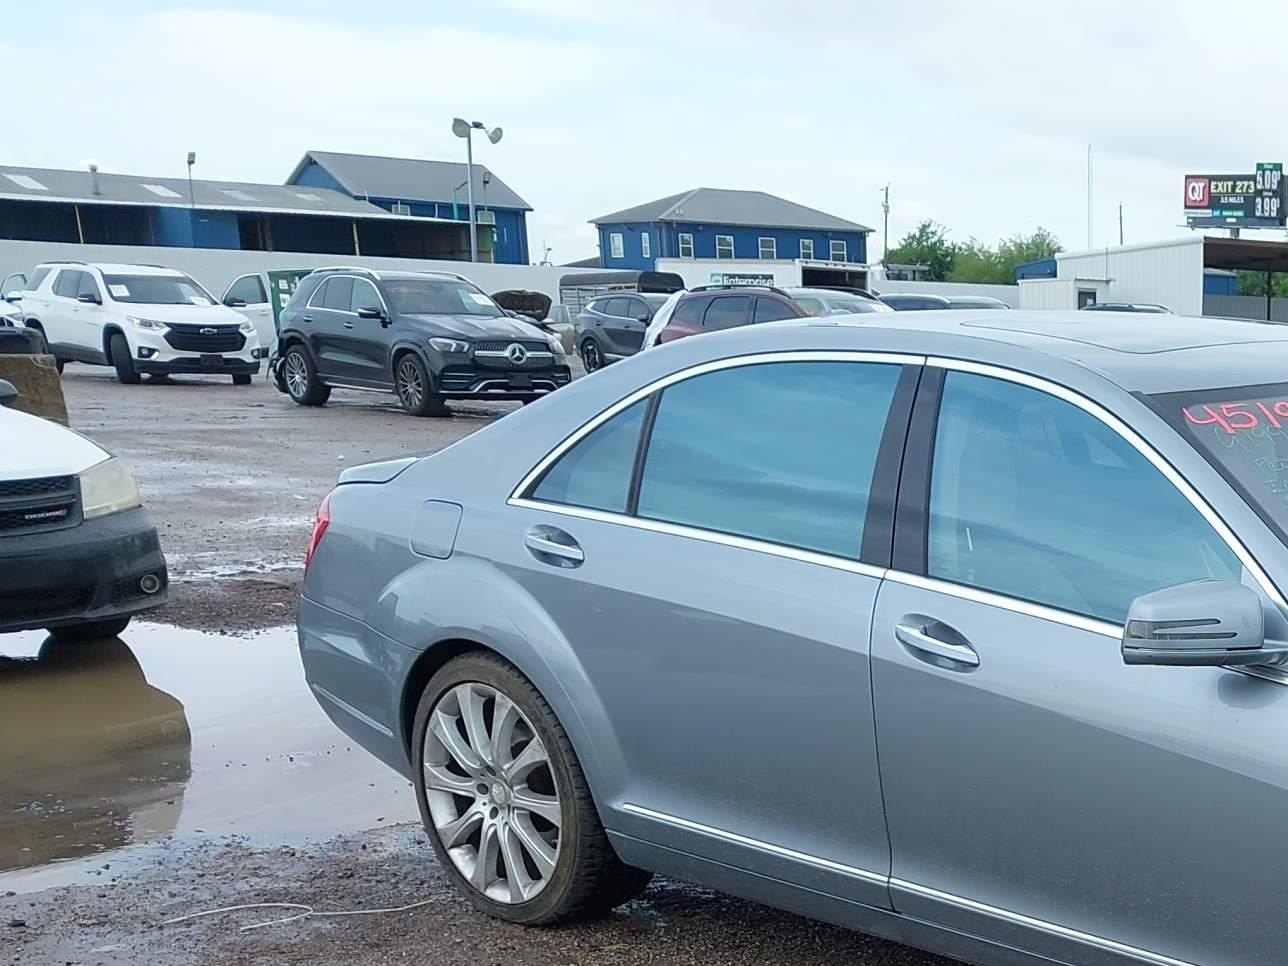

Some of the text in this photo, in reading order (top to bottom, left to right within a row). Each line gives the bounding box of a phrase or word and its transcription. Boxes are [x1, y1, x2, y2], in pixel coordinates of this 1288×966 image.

[1188, 182, 1205, 201] QT
[1210, 181, 1255, 193] EXIT 273
